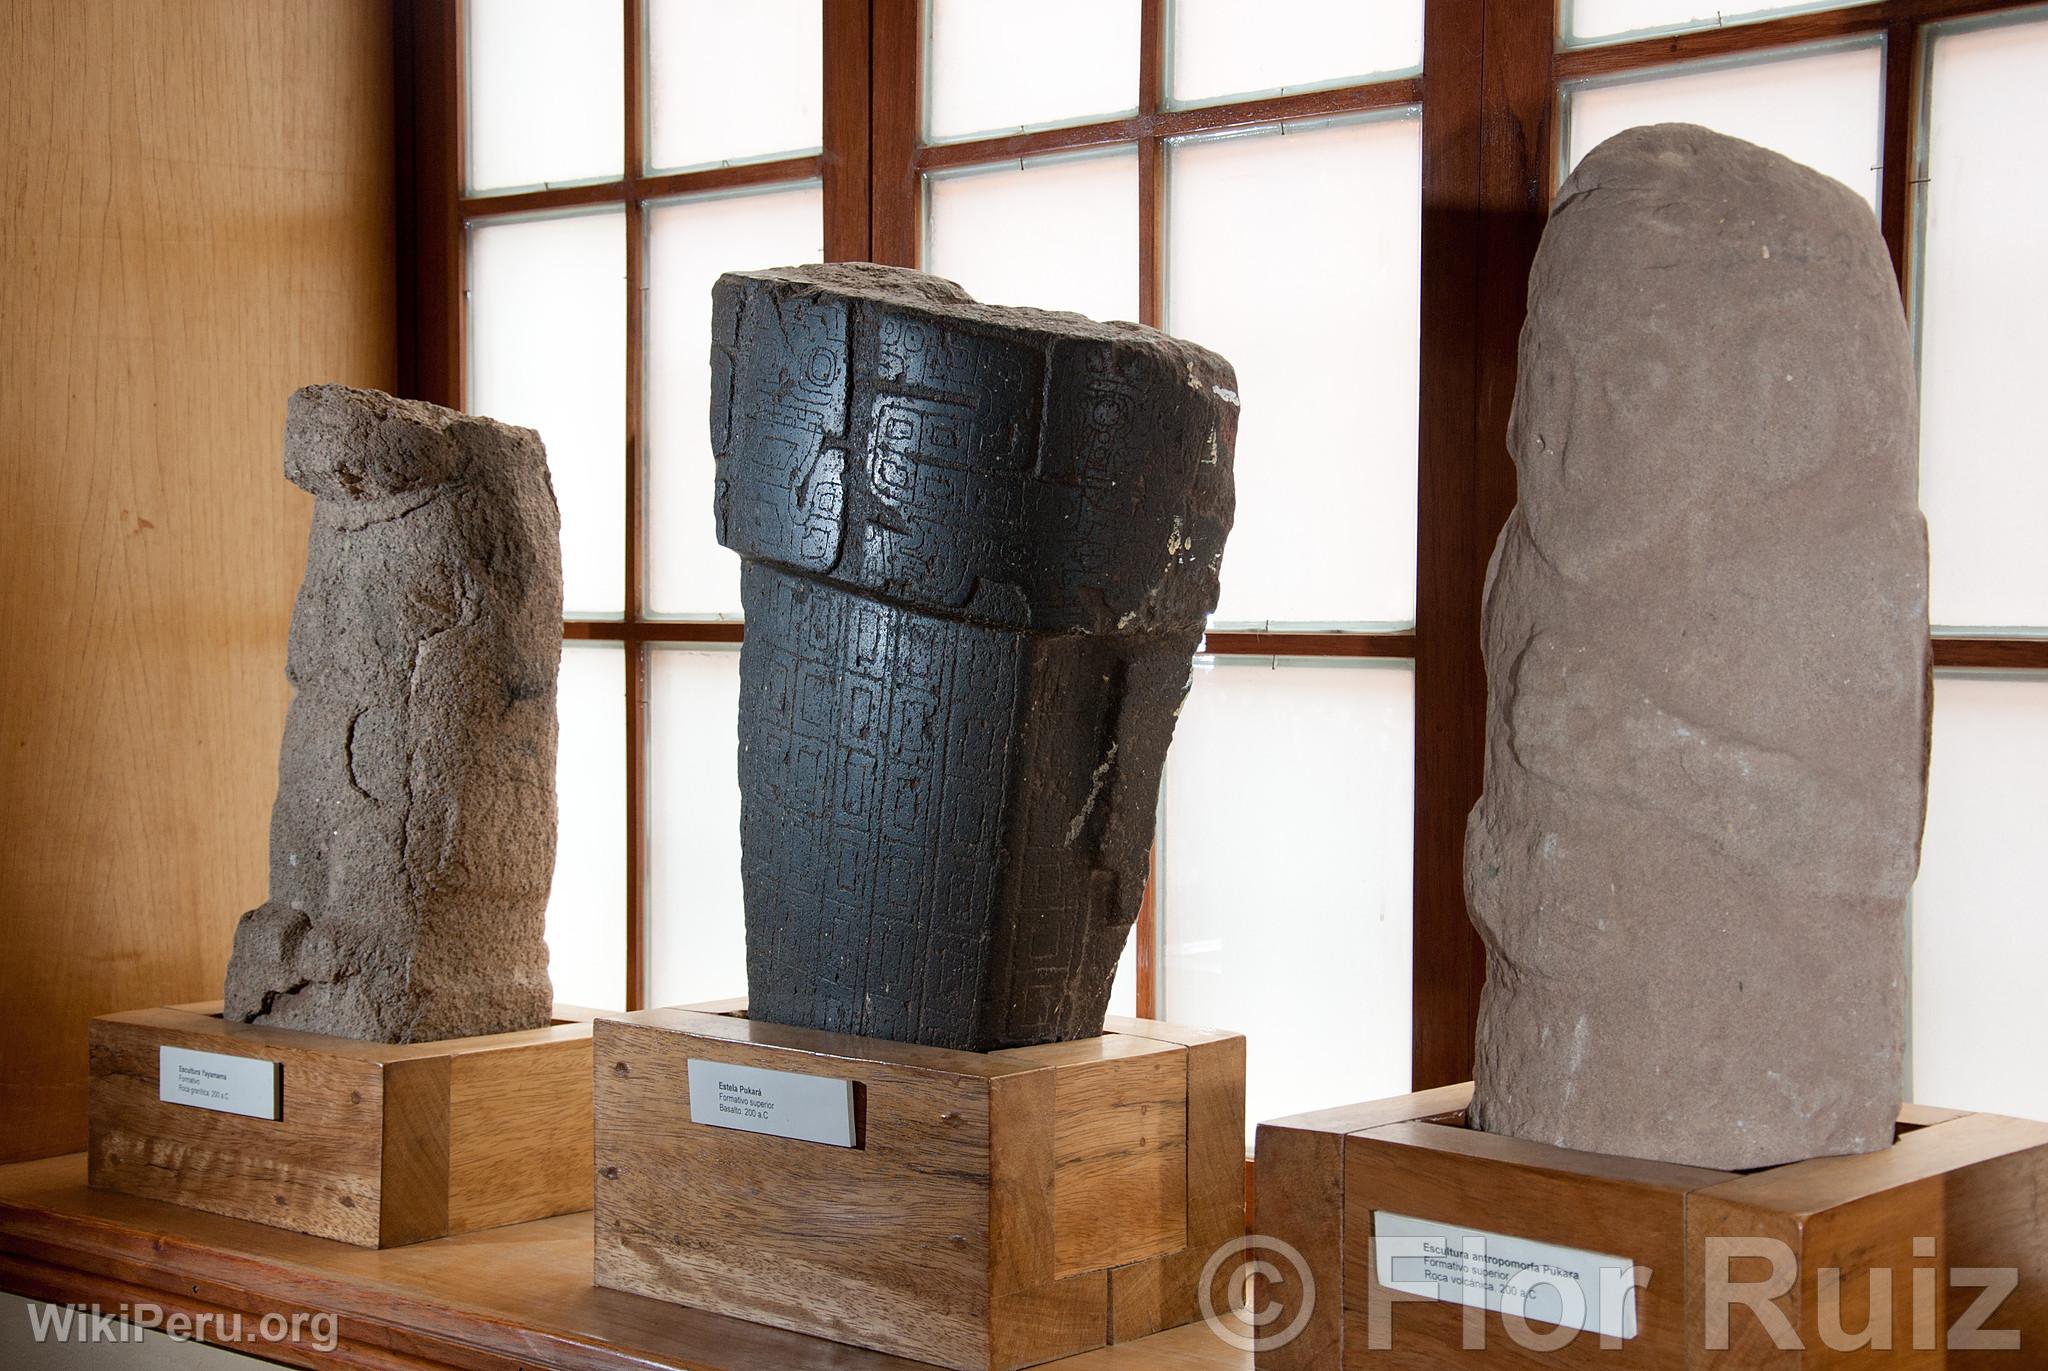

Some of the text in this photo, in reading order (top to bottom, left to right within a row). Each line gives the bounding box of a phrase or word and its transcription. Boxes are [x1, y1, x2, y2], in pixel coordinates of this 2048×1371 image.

[719, 1081, 738, 1092] Estela
[719, 1092, 775, 1110] Formativo superior
[744, 1108, 757, 1118] 200
[1423, 1243, 1470, 1260] Escultura
[1472, 1254, 1540, 1274] antropomorfa
[1423, 1256, 1510, 1281] Formativo superior
[1424, 1269, 1449, 1283] Roca
[1500, 1283, 1518, 1297] 200
